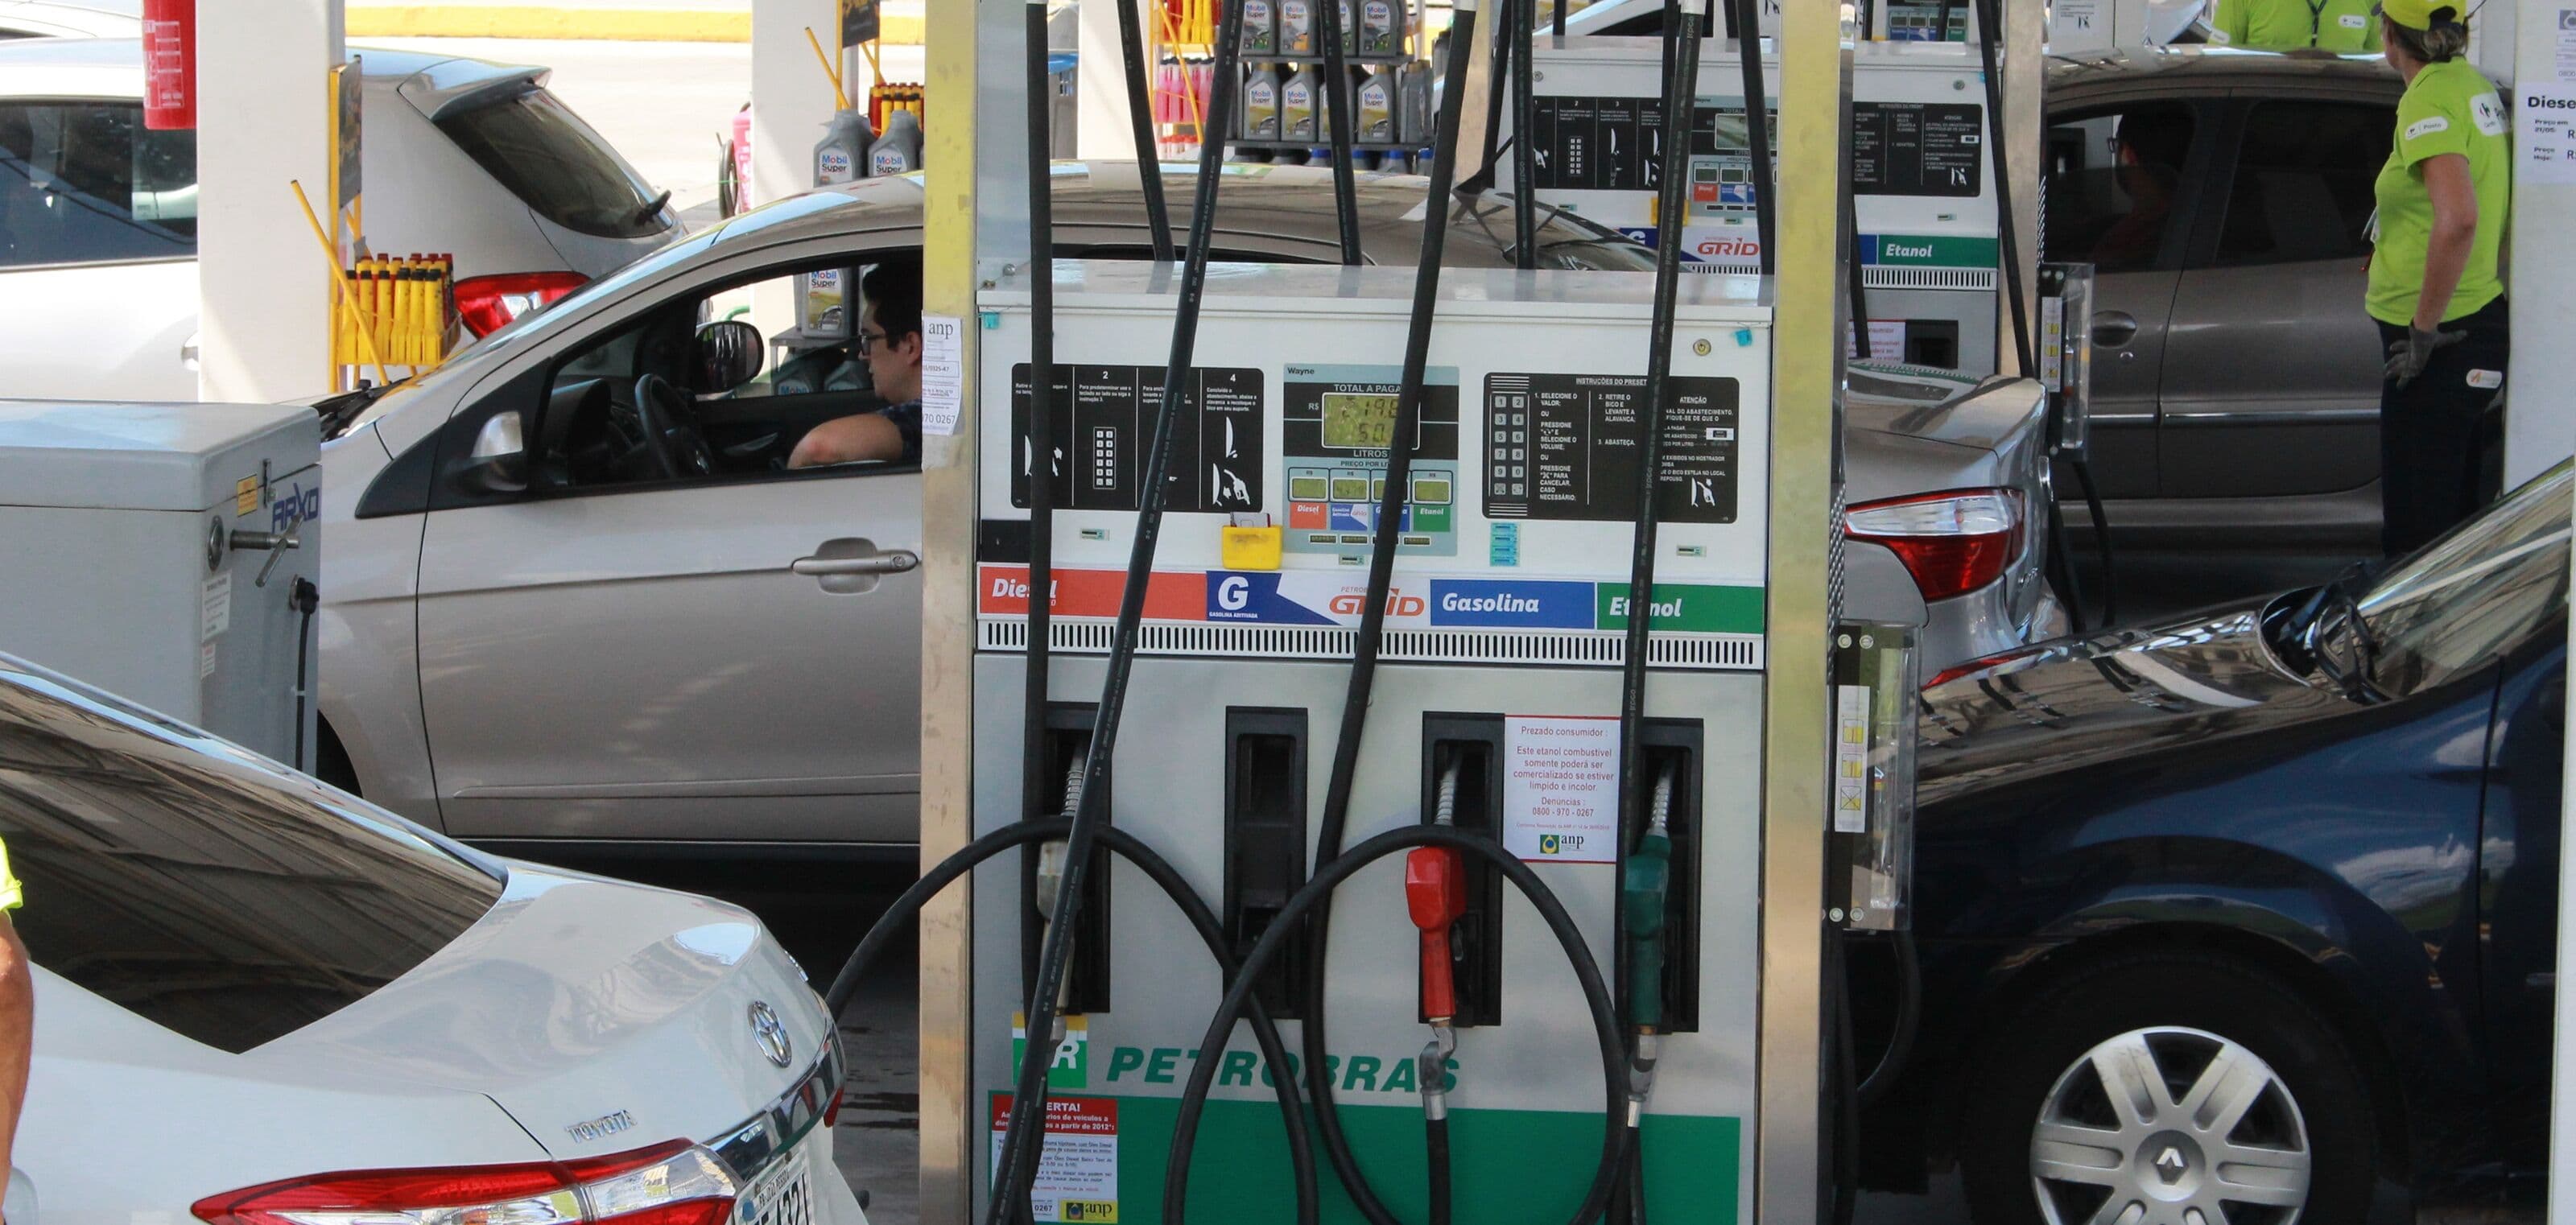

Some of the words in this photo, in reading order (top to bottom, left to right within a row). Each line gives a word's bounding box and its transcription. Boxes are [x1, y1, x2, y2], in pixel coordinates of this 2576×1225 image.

[1288, 90, 1307, 98] Mobil
[2528, 96, 2576, 109] Diese
[822, 155, 847, 164] Mobil
[876, 155, 902, 165] Mobil
[822, 163, 847, 173] Super
[876, 164, 901, 173] Super
[1886, 243, 1933, 258] Etanol
[811, 270, 837, 279] Mobil
[811, 278, 836, 287] Super
[928, 323, 953, 339] anp
[1102, 371, 1108, 379] 2
[1288, 367, 1315, 376] Wayne
[1230, 373, 1236, 382] 4
[1576, 377, 1613, 386] INSTRUÇÕES
[1624, 378, 1647, 386] PRESET
[1334, 384, 1364, 392] TOTAL
[1376, 385, 1402, 393] PAGA
[1680, 396, 1707, 404] ATENÇÃO
[1308, 402, 1319, 410] R$
[935, 414, 956, 425] 0267
[1353, 449, 1388, 458] LITROS
[1340, 460, 1364, 468] PREÇO
[1297, 504, 1320, 513] Diesel
[992, 578, 1058, 599] Diel
[1218, 575, 1249, 611] G
[1442, 592, 1539, 613] Gasolina
[1609, 596, 1682, 617] Etnol
[1521, 726, 1554, 736] Prezado
[1555, 728, 1604, 738] consumidor
[1517, 745, 1534, 755] Este
[1536, 746, 1562, 756] etanol
[1524, 760, 1558, 768] somente
[1561, 759, 1589, 769] poderá
[1513, 769, 1573, 780] comercializado
[1587, 772, 1614, 781] estiver
[1542, 796, 1581, 806] Denúncias
[1533, 807, 1550, 816] 0800
[1557, 808, 1570, 816] 970
[1576, 808, 1594, 817] 0267
[1561, 835, 1584, 849] anp
[1046, 1102, 1080, 1112] ERTA!
[565, 1109, 638, 1144] TOYOTA
[1061, 1123, 1080, 1131] partir
[1085, 1202, 1113, 1217] anp
